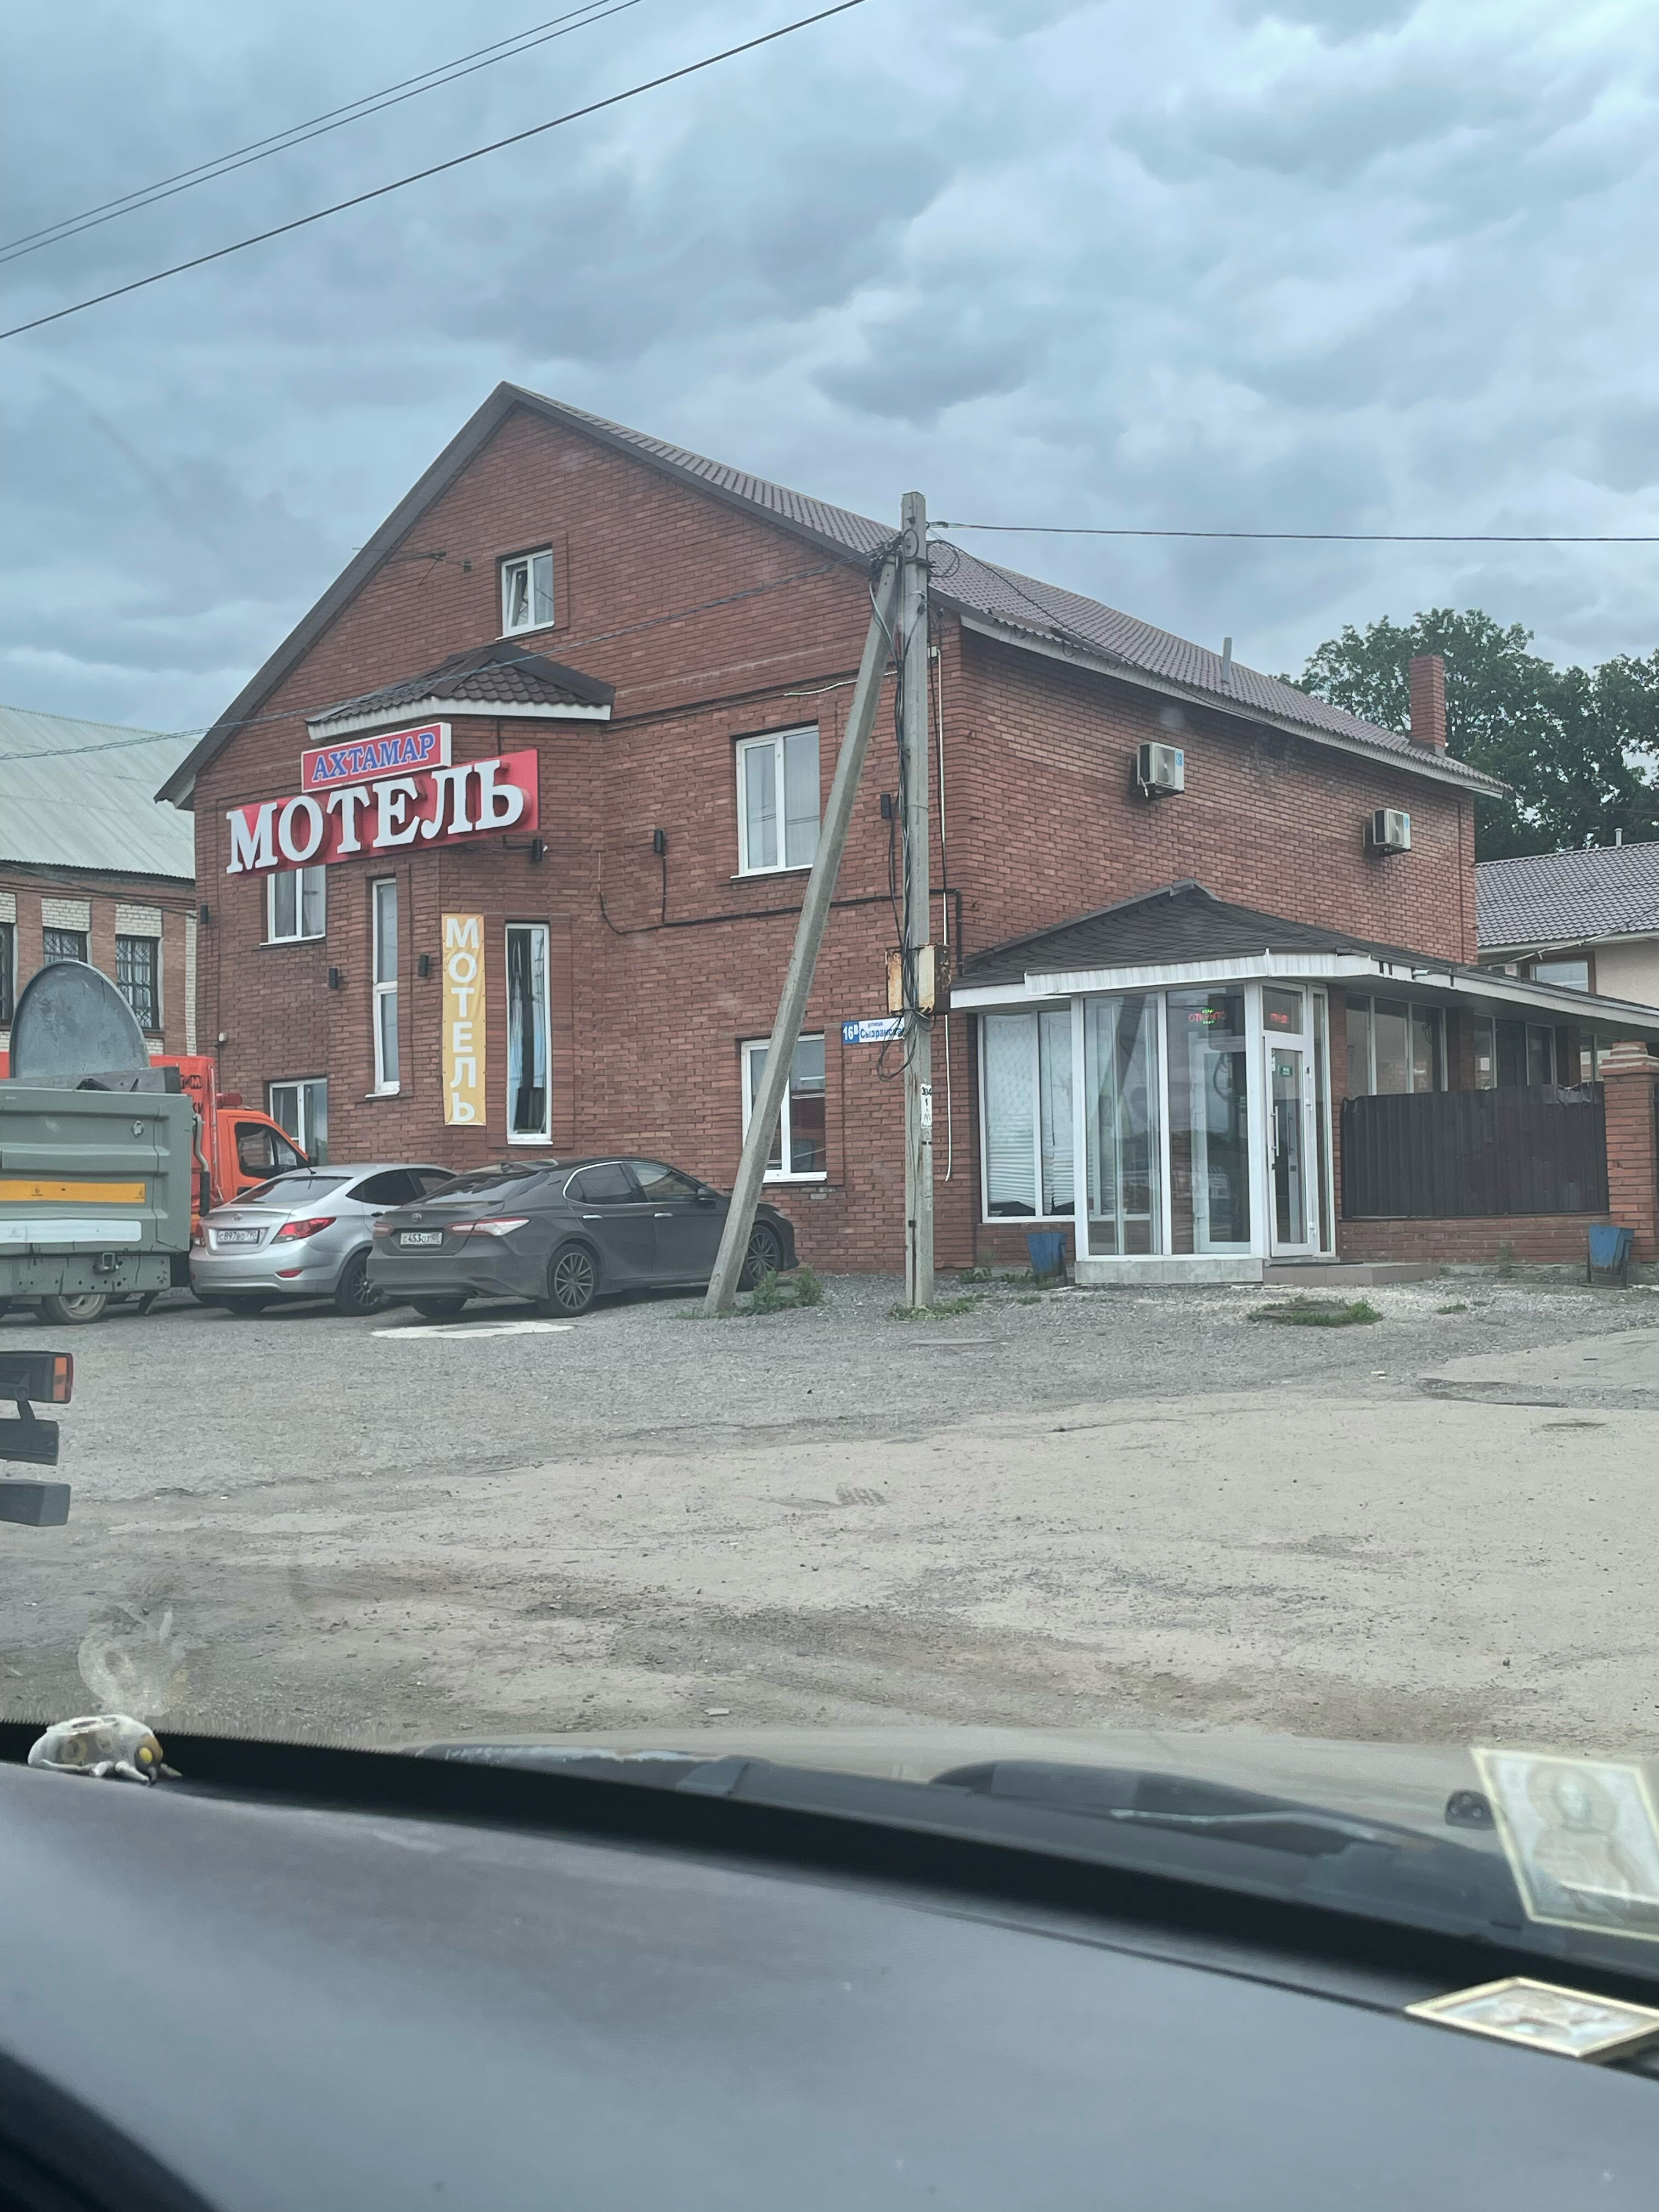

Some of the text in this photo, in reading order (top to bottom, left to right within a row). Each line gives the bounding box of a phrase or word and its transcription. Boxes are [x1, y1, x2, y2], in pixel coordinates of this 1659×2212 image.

[312, 732, 435, 782] АХТАМАР
[226, 760, 525, 873] МОТЕЛЬ
[445, 918, 479, 1122] МОТЕЛЬ
